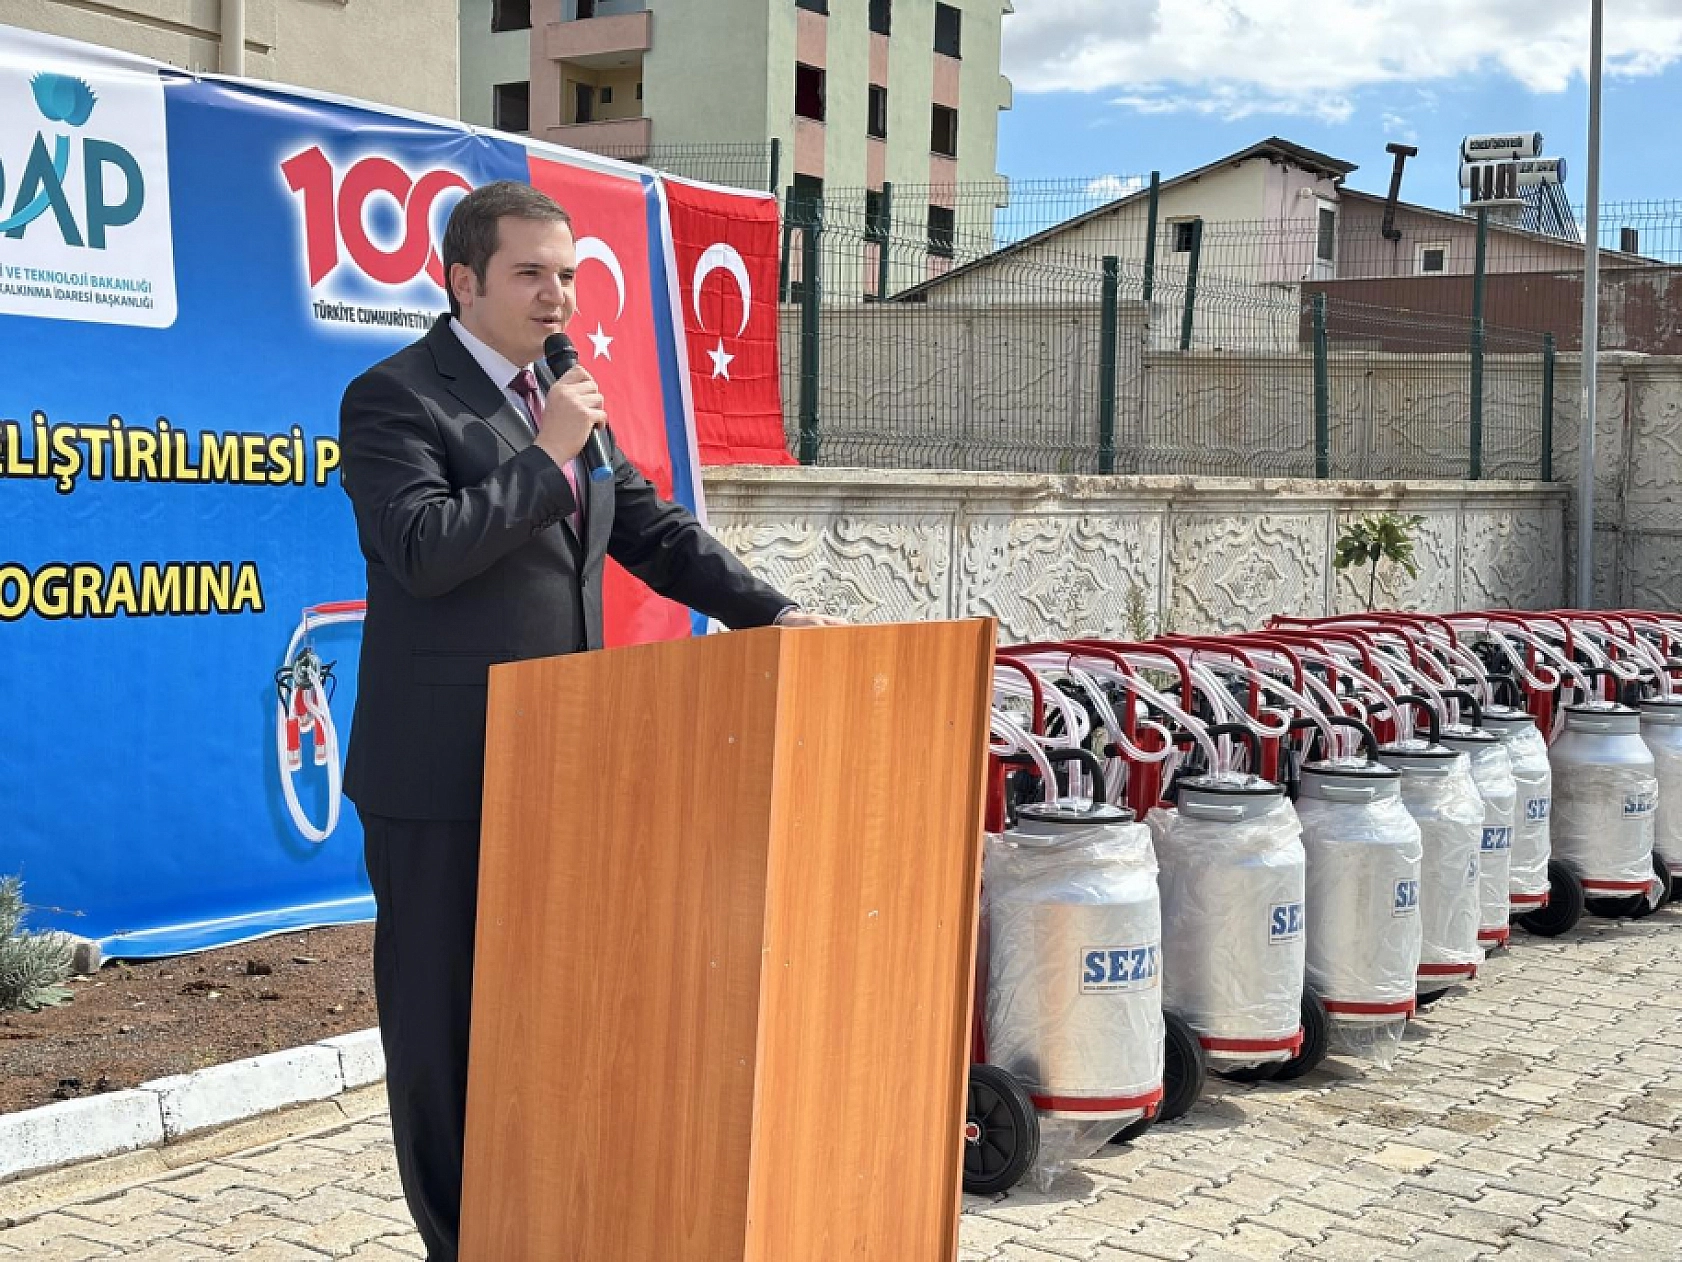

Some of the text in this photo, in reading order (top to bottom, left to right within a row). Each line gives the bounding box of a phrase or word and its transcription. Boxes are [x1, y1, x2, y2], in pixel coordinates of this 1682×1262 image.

[0, 130, 145, 250] AP
[5, 265, 21, 280] VE
[24, 267, 88, 287] TEKNOLOJİ
[90, 275, 151, 293] BAKANLIĞI
[53, 287, 93, 303] İDARESİ
[95, 292, 153, 309] BAŞKANLIĞI
[312, 300, 355, 322] TÜRKİYE
[0, 411, 305, 494] LİŞTİRİLMESİ
